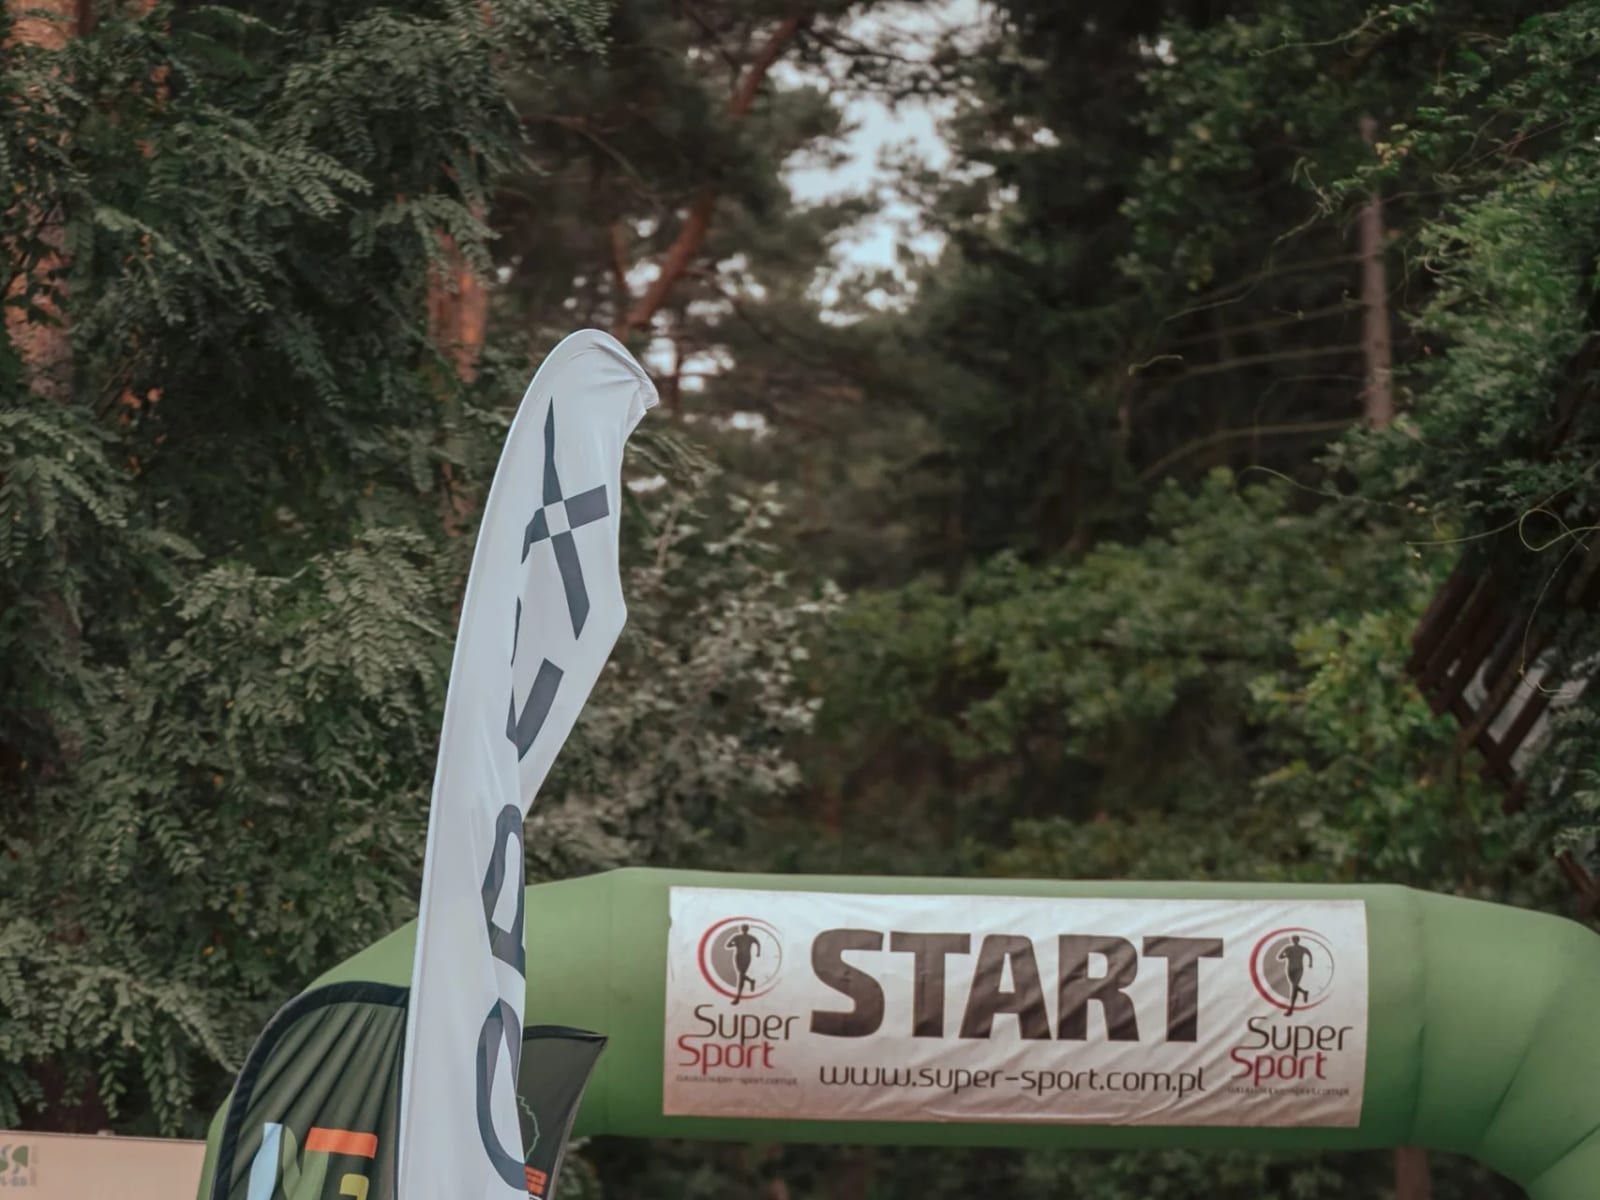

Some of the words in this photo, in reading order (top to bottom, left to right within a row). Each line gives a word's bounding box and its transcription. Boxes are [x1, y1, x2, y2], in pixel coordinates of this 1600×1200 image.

[809, 928, 1224, 1044] START
[693, 1004, 800, 1047] Super
[1247, 1016, 1354, 1058] Super
[677, 1034, 775, 1075] Sport
[1230, 1046, 1328, 1087] Sport
[819, 1064, 1207, 1097] www.super-sport.com.pl
